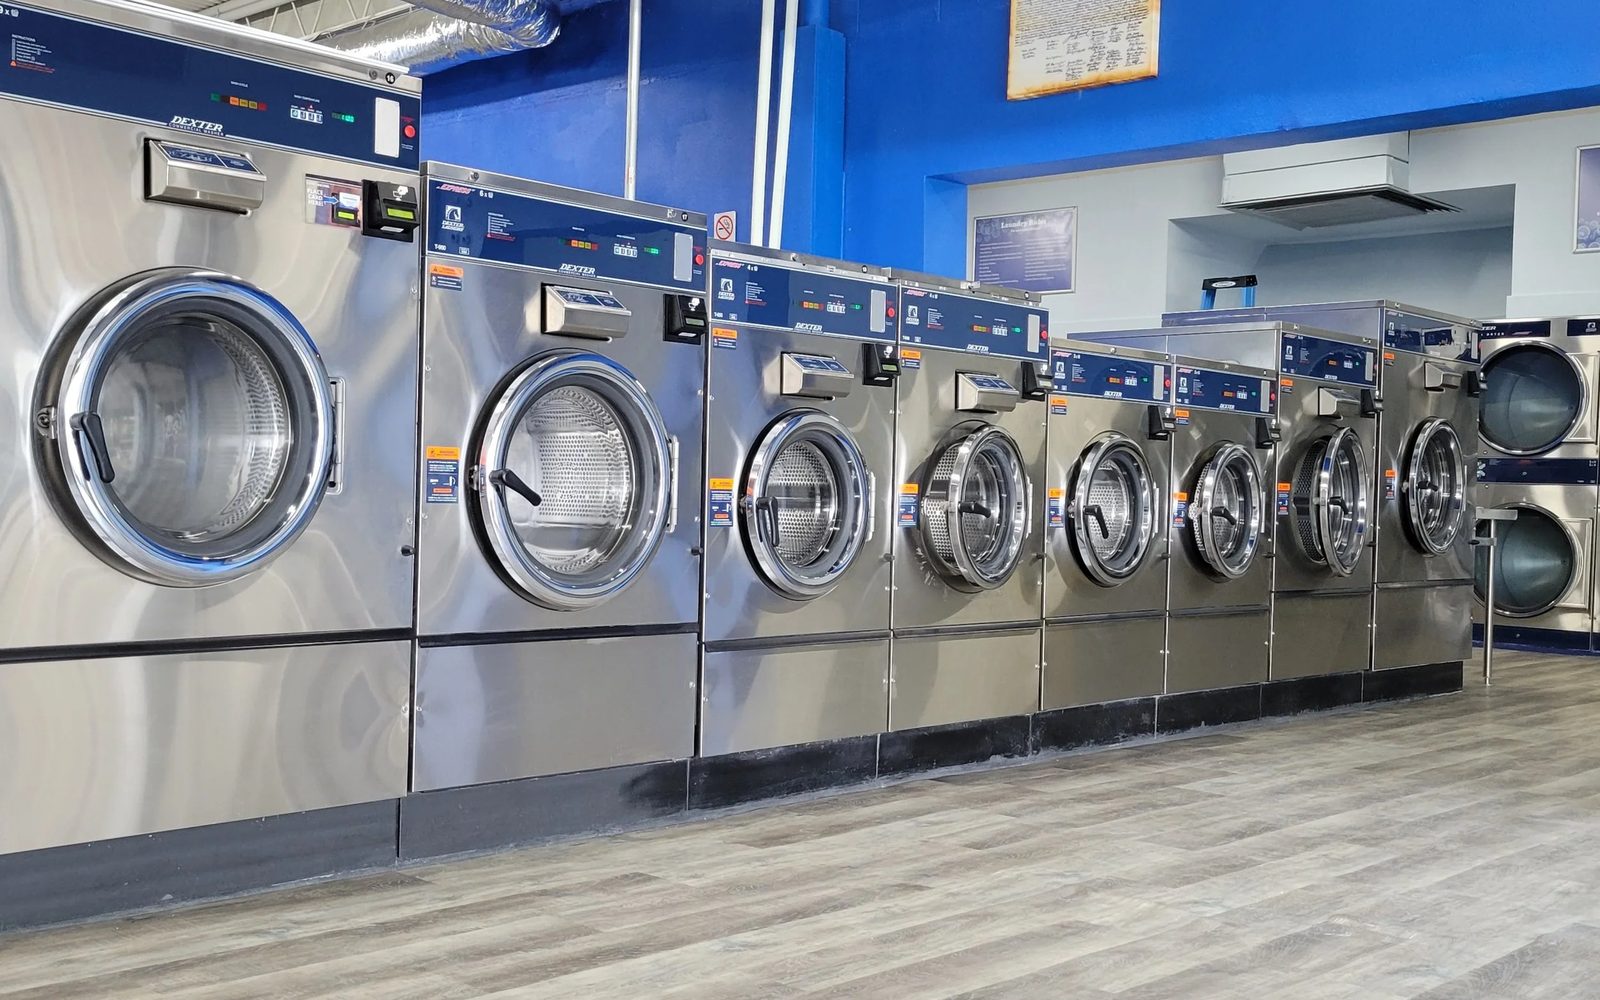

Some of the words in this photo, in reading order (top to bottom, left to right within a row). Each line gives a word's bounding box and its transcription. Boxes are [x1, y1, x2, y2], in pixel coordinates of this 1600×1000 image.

[170, 115, 223, 132] DEXTER
[1001, 219, 1028, 229] Laundry
[1028, 218, 1047, 226] Rules
[560, 263, 595, 274] DEXTER
[795, 322, 823, 331] DEXTER
[966, 344, 989, 352] DEXTER
